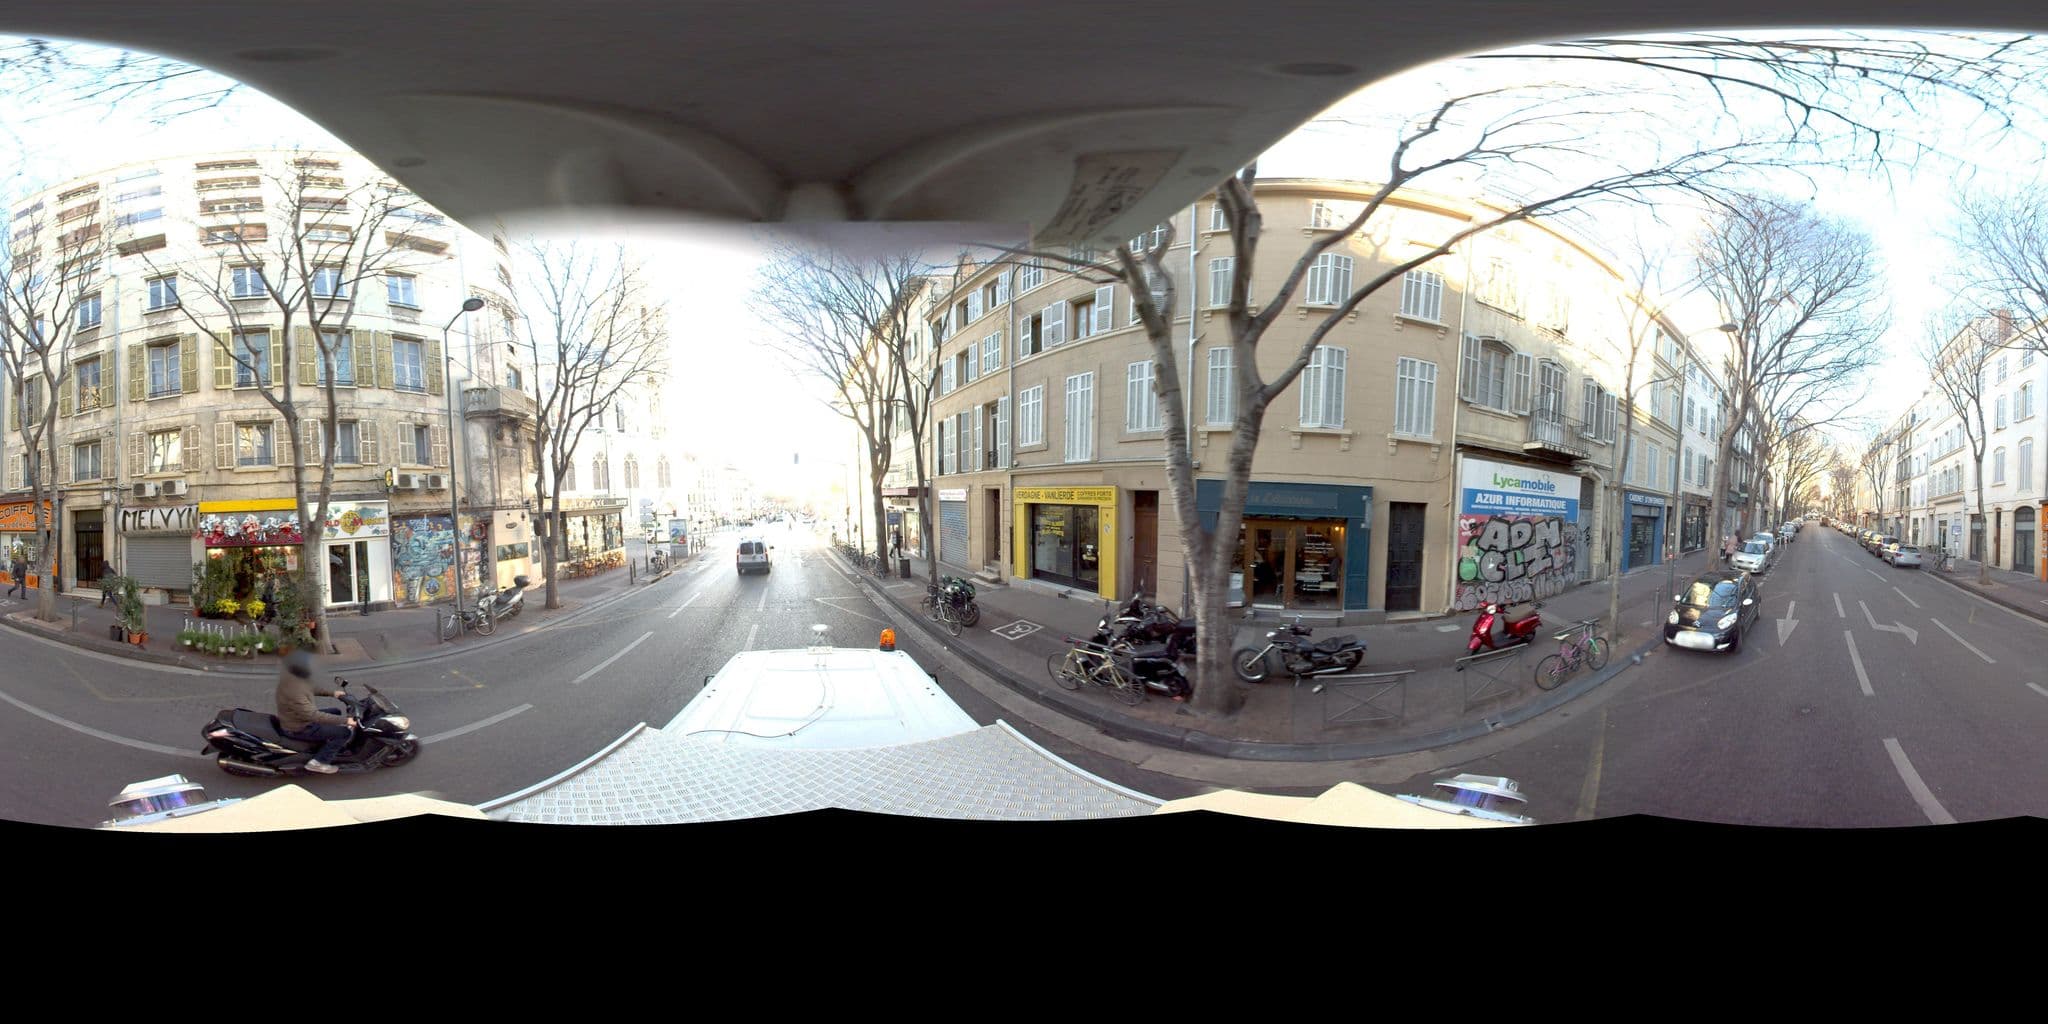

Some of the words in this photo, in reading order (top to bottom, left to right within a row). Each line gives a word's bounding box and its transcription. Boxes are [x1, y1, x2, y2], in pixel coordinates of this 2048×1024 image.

[1493, 473, 1556, 492] Lycamobile
[1475, 493, 1503, 505] AZUR
[1505, 495, 1567, 510] INFORMATIQUE
[122, 507, 199, 531] MELVYN
